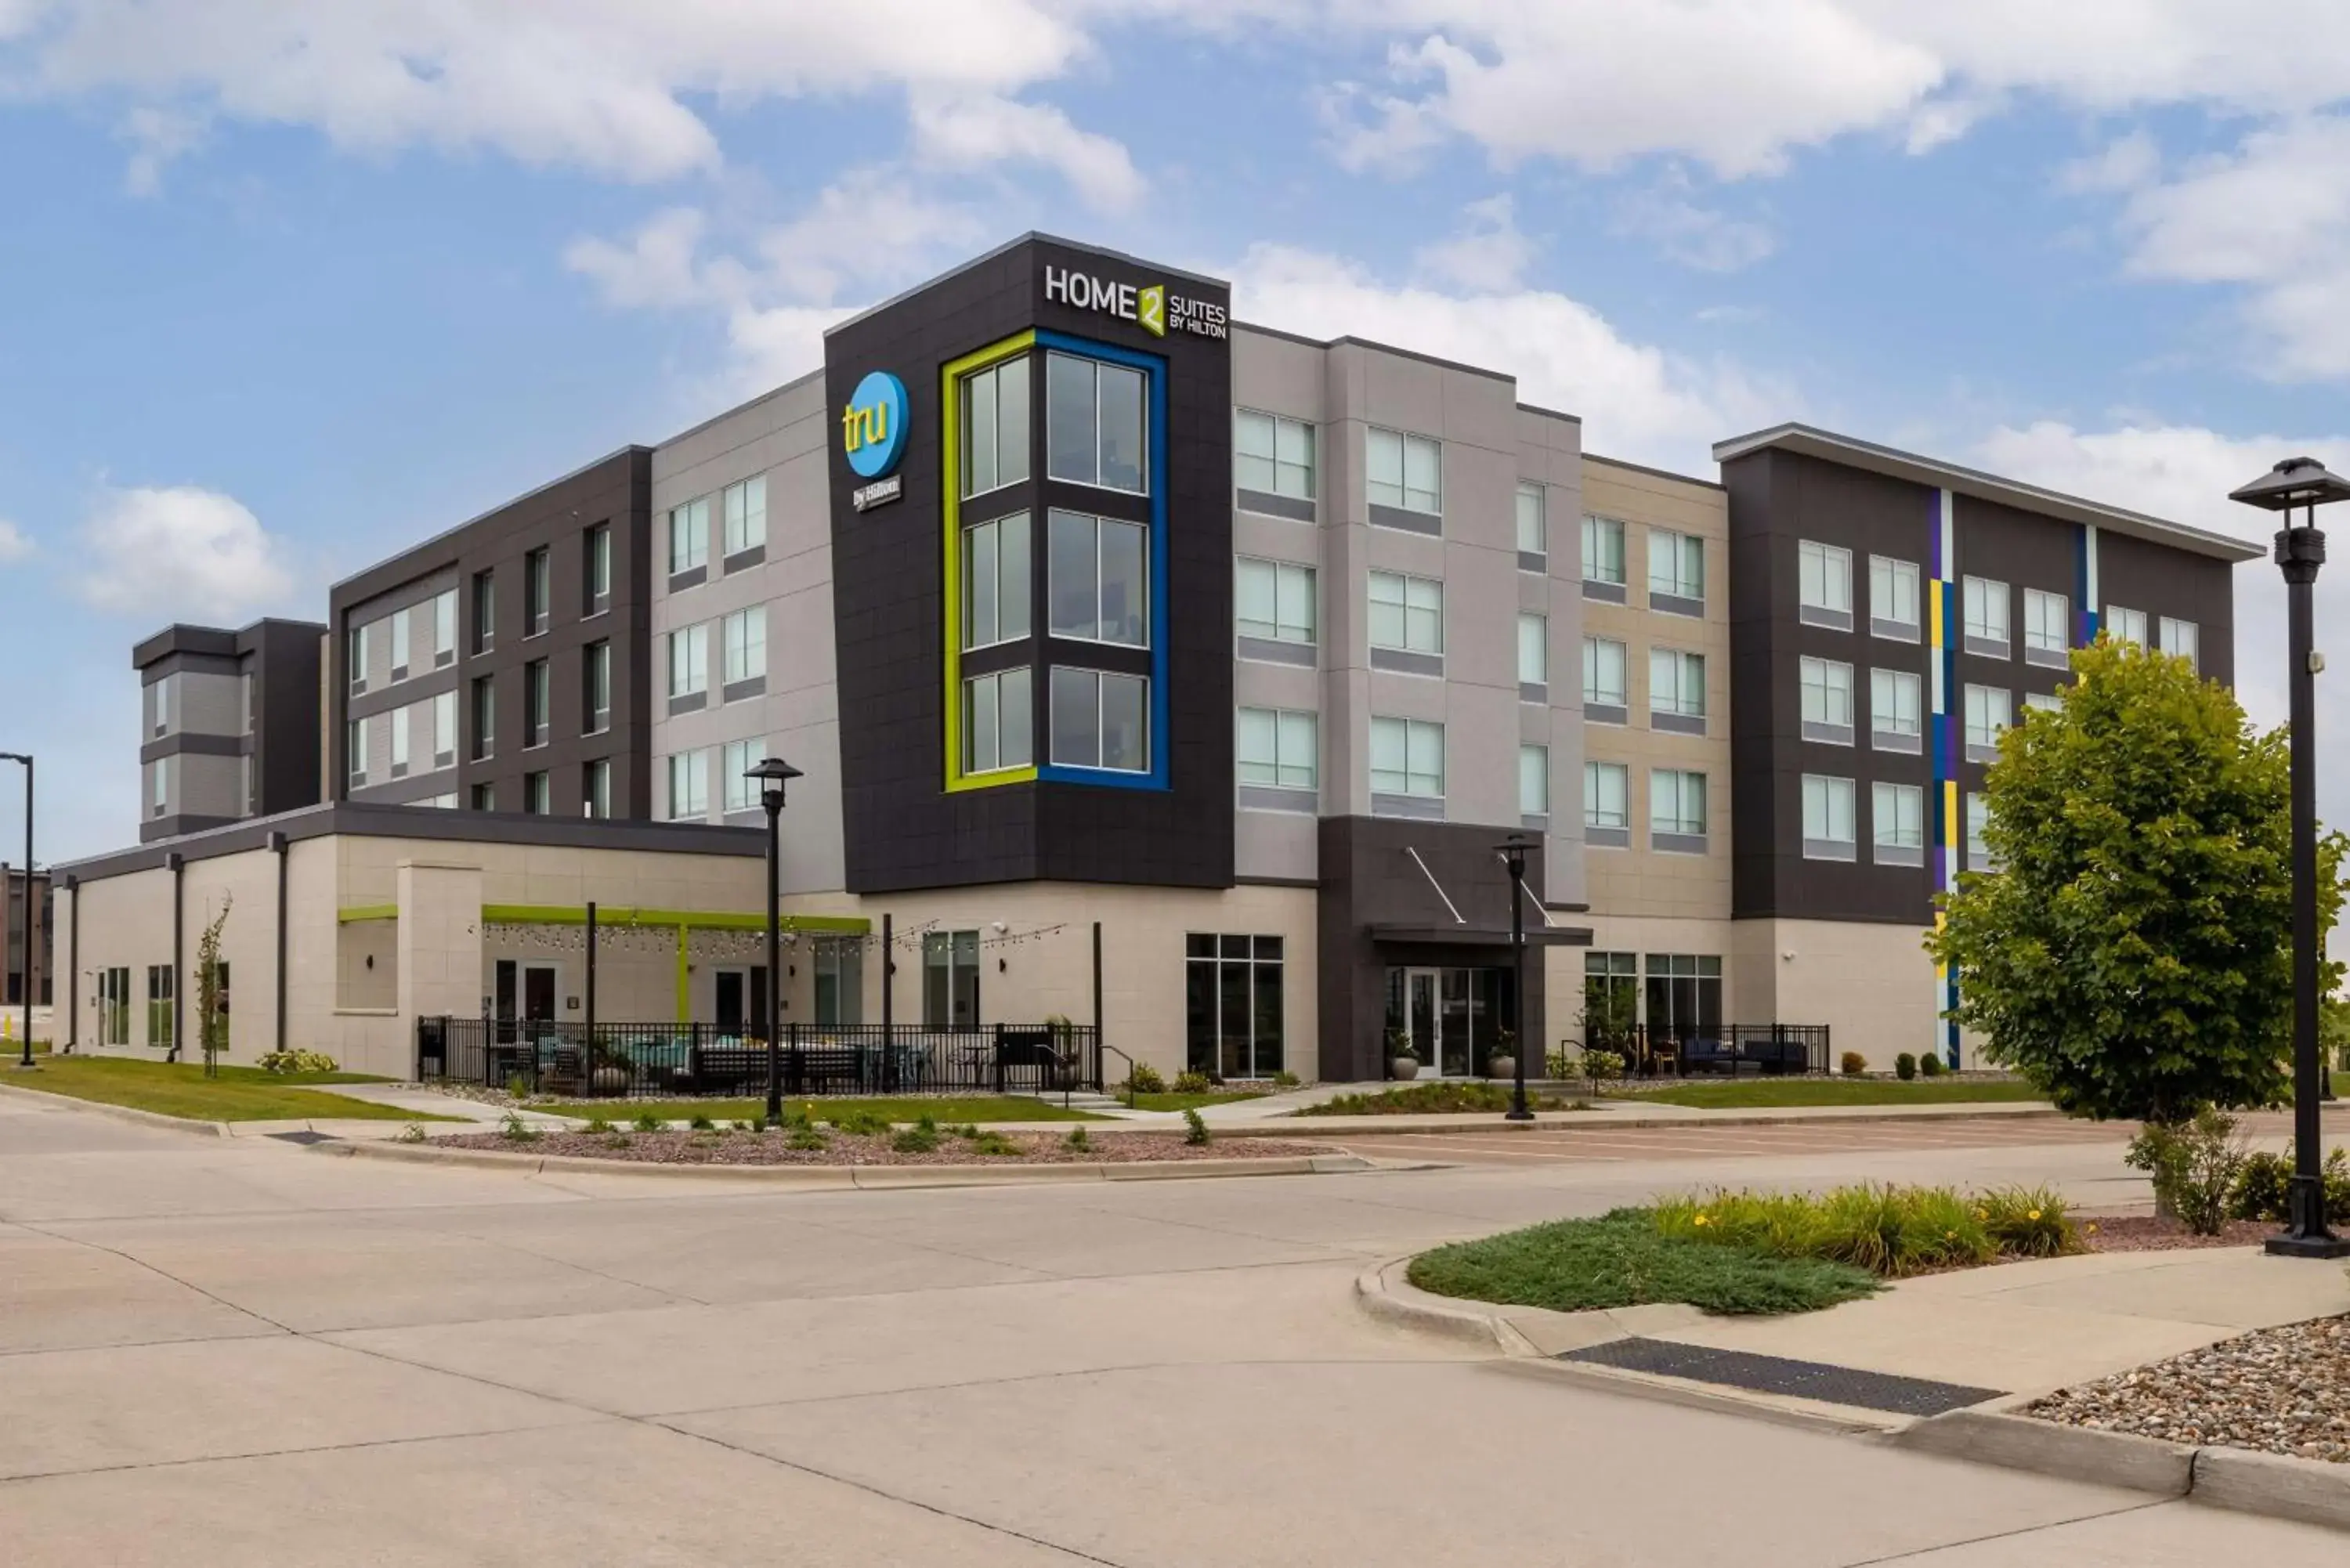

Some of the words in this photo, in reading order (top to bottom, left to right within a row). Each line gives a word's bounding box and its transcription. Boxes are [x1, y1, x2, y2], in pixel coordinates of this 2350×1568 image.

[1170, 295, 1226, 323] SUITES
[1170, 314, 1185, 331] BY
[1187, 318, 1227, 339] HILTON
[842, 401, 887, 453] tru
[866, 480, 900, 502] Hilton
